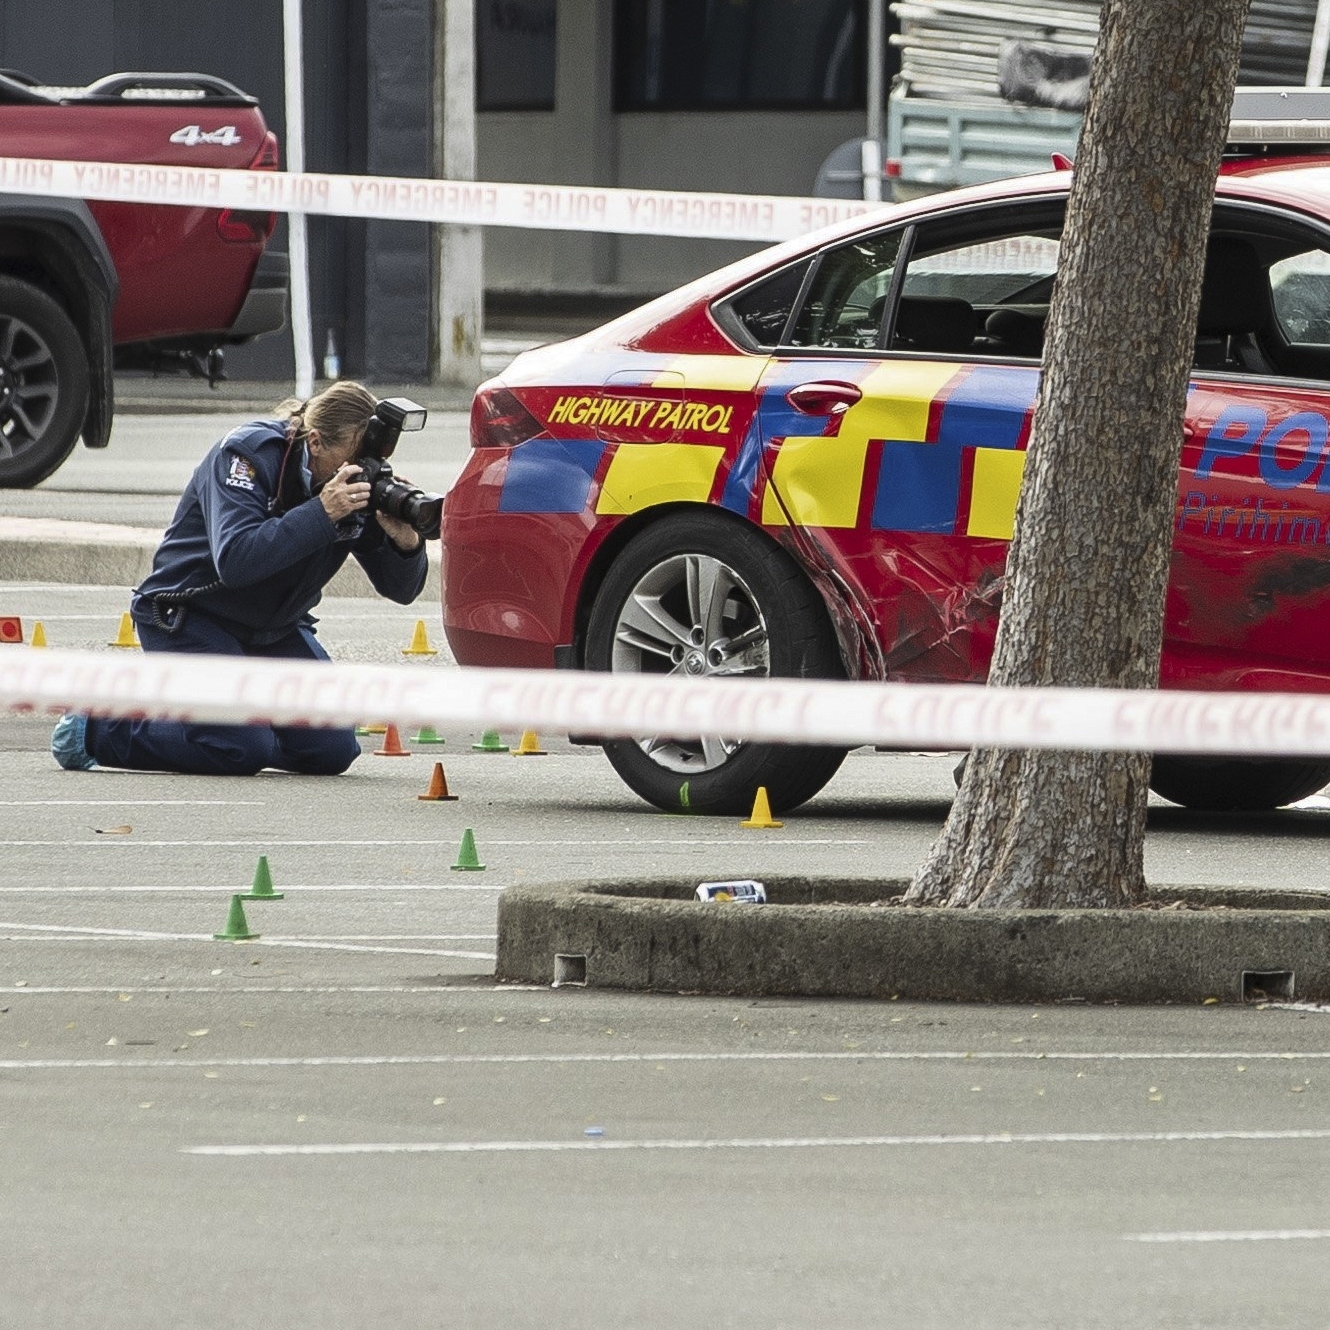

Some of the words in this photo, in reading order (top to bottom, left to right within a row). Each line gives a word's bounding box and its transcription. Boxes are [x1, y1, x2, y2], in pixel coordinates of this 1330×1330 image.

[547, 396, 653, 427] HIGHWAY
[648, 401, 733, 434] PATROL
[225, 477, 256, 491] POLICE
